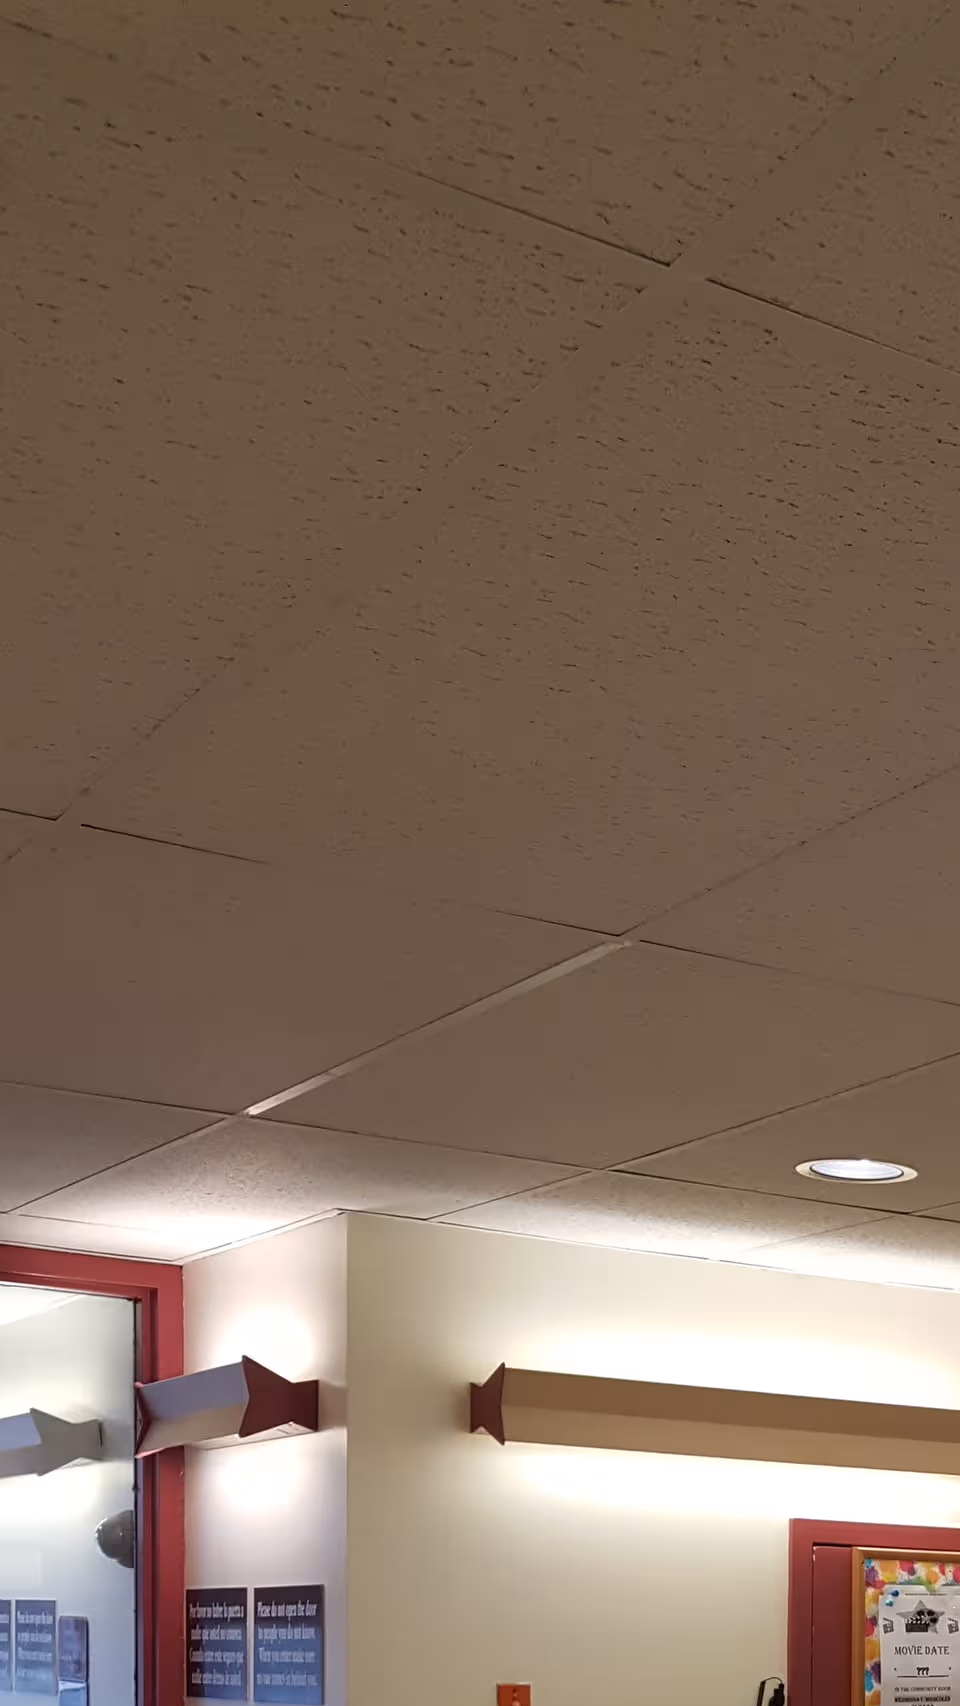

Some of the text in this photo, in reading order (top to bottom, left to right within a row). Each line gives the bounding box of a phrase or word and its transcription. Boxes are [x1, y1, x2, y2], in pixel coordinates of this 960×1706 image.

[258, 1602, 270, 1616] Please
[271, 1600, 277, 1616] do
[286, 1603, 296, 1621] open
[305, 1600, 317, 1616] door
[894, 1645, 950, 1656] MOVIE DATE
[916, 1666, 930, 1676] ???
